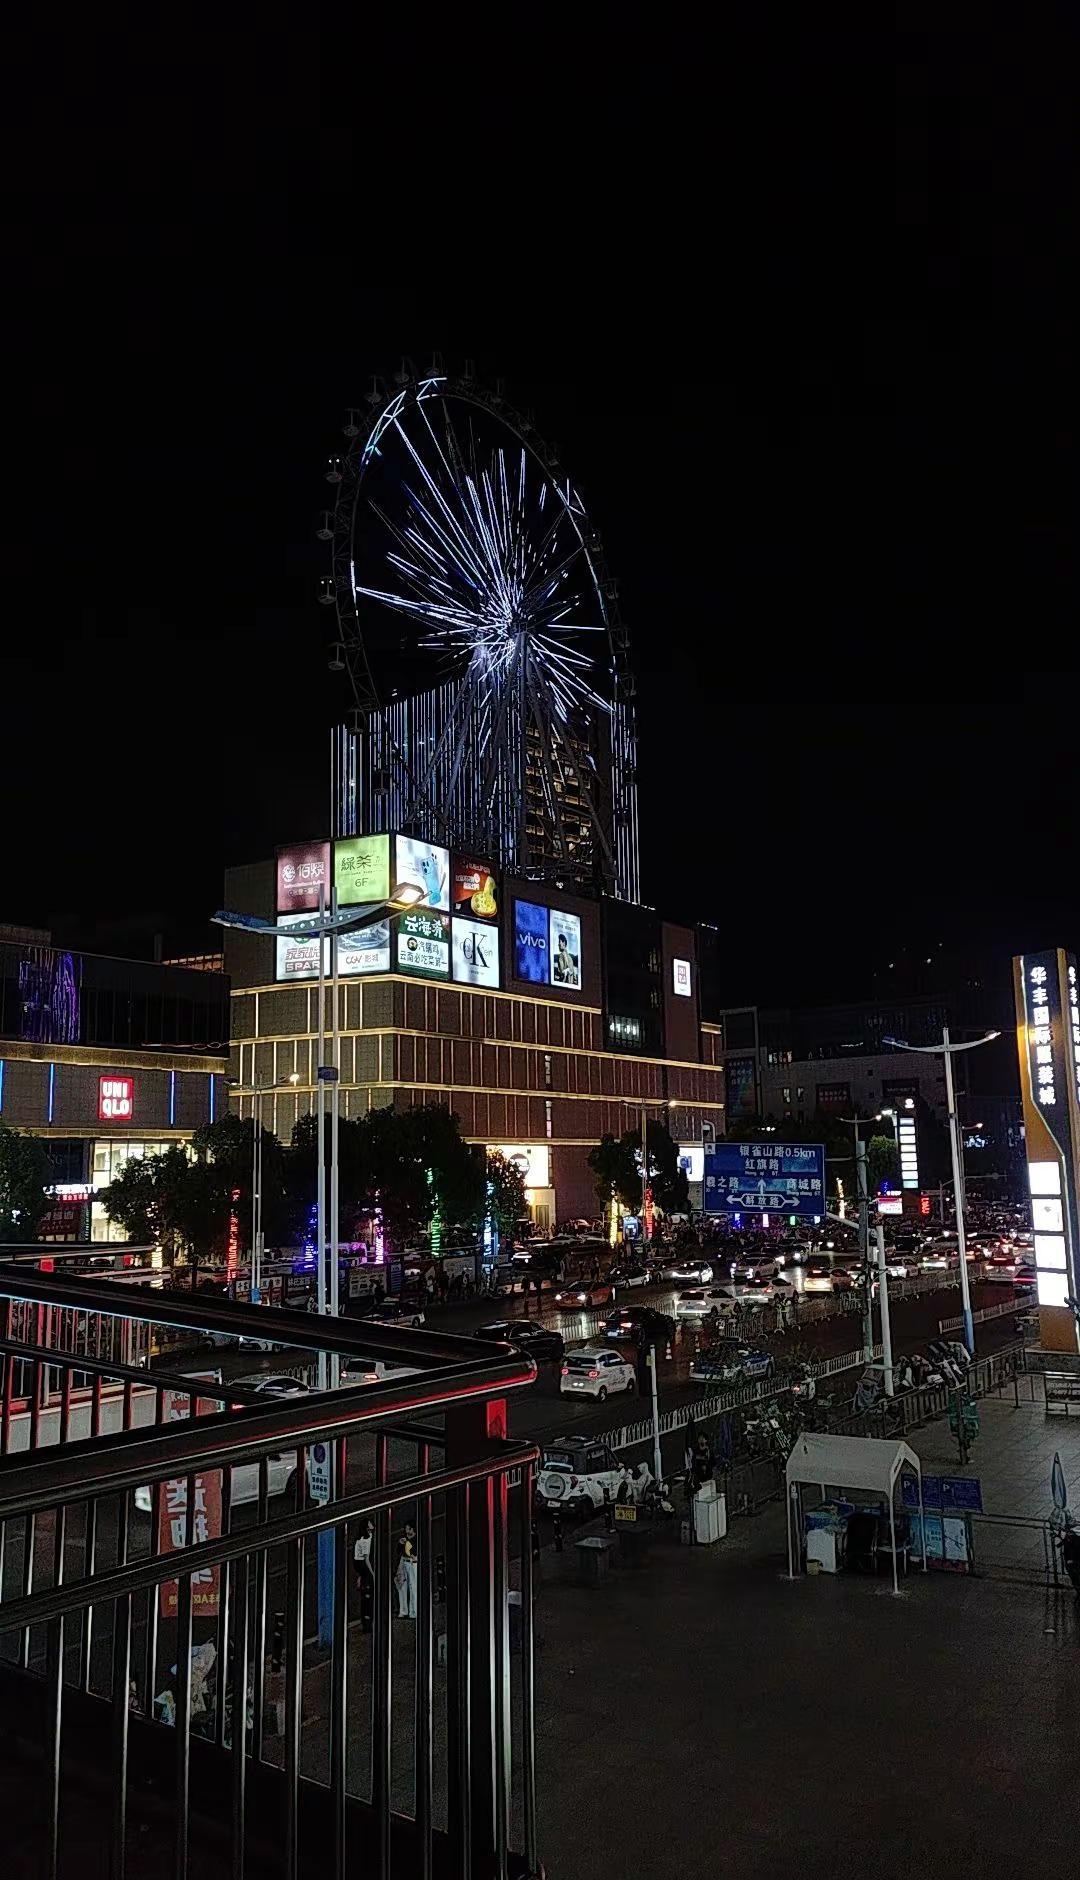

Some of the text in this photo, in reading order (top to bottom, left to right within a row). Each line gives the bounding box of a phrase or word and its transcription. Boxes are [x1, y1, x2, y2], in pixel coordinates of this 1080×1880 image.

[355, 878, 369, 887] 6F
[519, 931, 546, 949] vivo
[287, 961, 320, 972] SPAR
[103, 1081, 128, 1098] UNI
[103, 1099, 129, 1116] QLO
[745, 1158, 779, 1170] 红旗路
[786, 1178, 821, 1191] 商城路
[745, 1196, 780, 1206] 解放路
